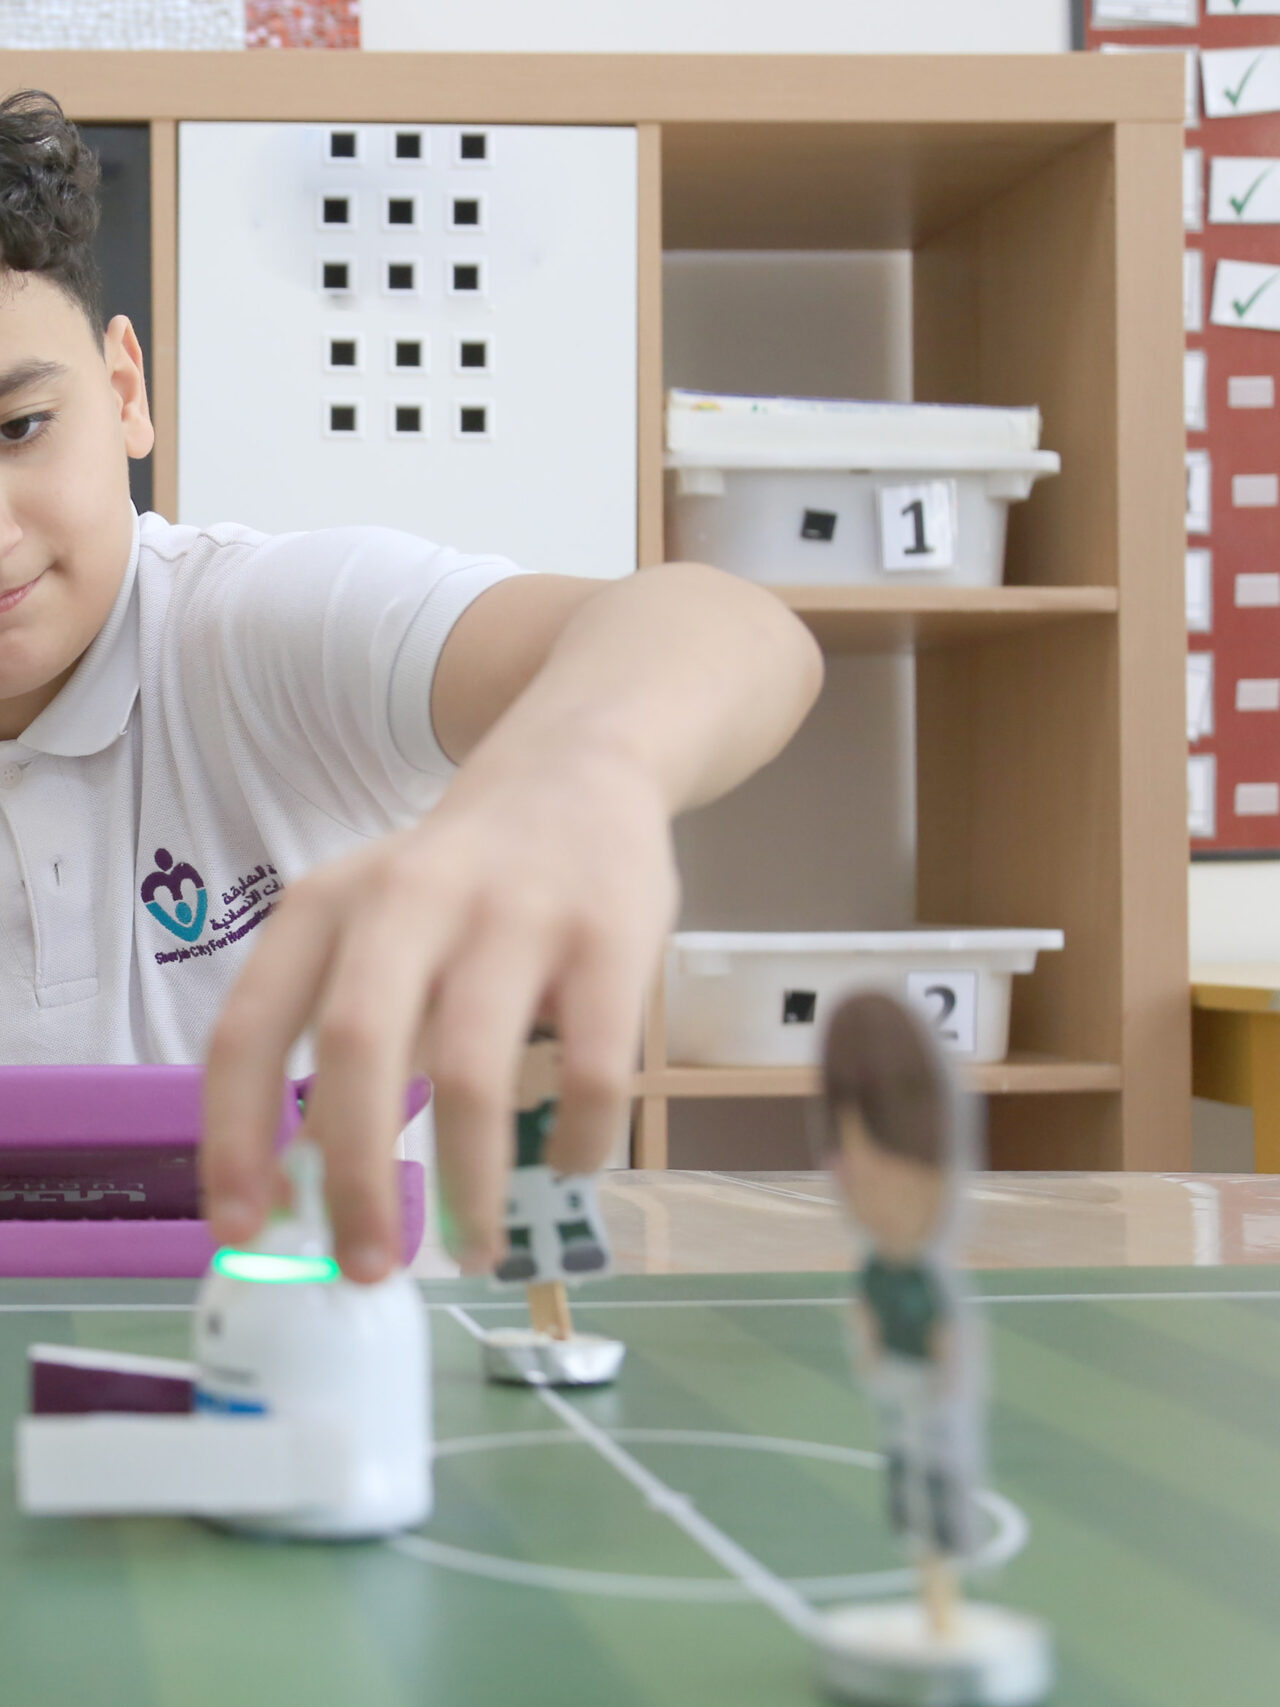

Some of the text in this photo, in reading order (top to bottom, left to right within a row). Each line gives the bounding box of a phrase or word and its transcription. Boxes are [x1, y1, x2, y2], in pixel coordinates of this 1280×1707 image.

[900, 499, 935, 556] 1
[208, 938, 228, 951] For
[924, 984, 959, 1041] 2
